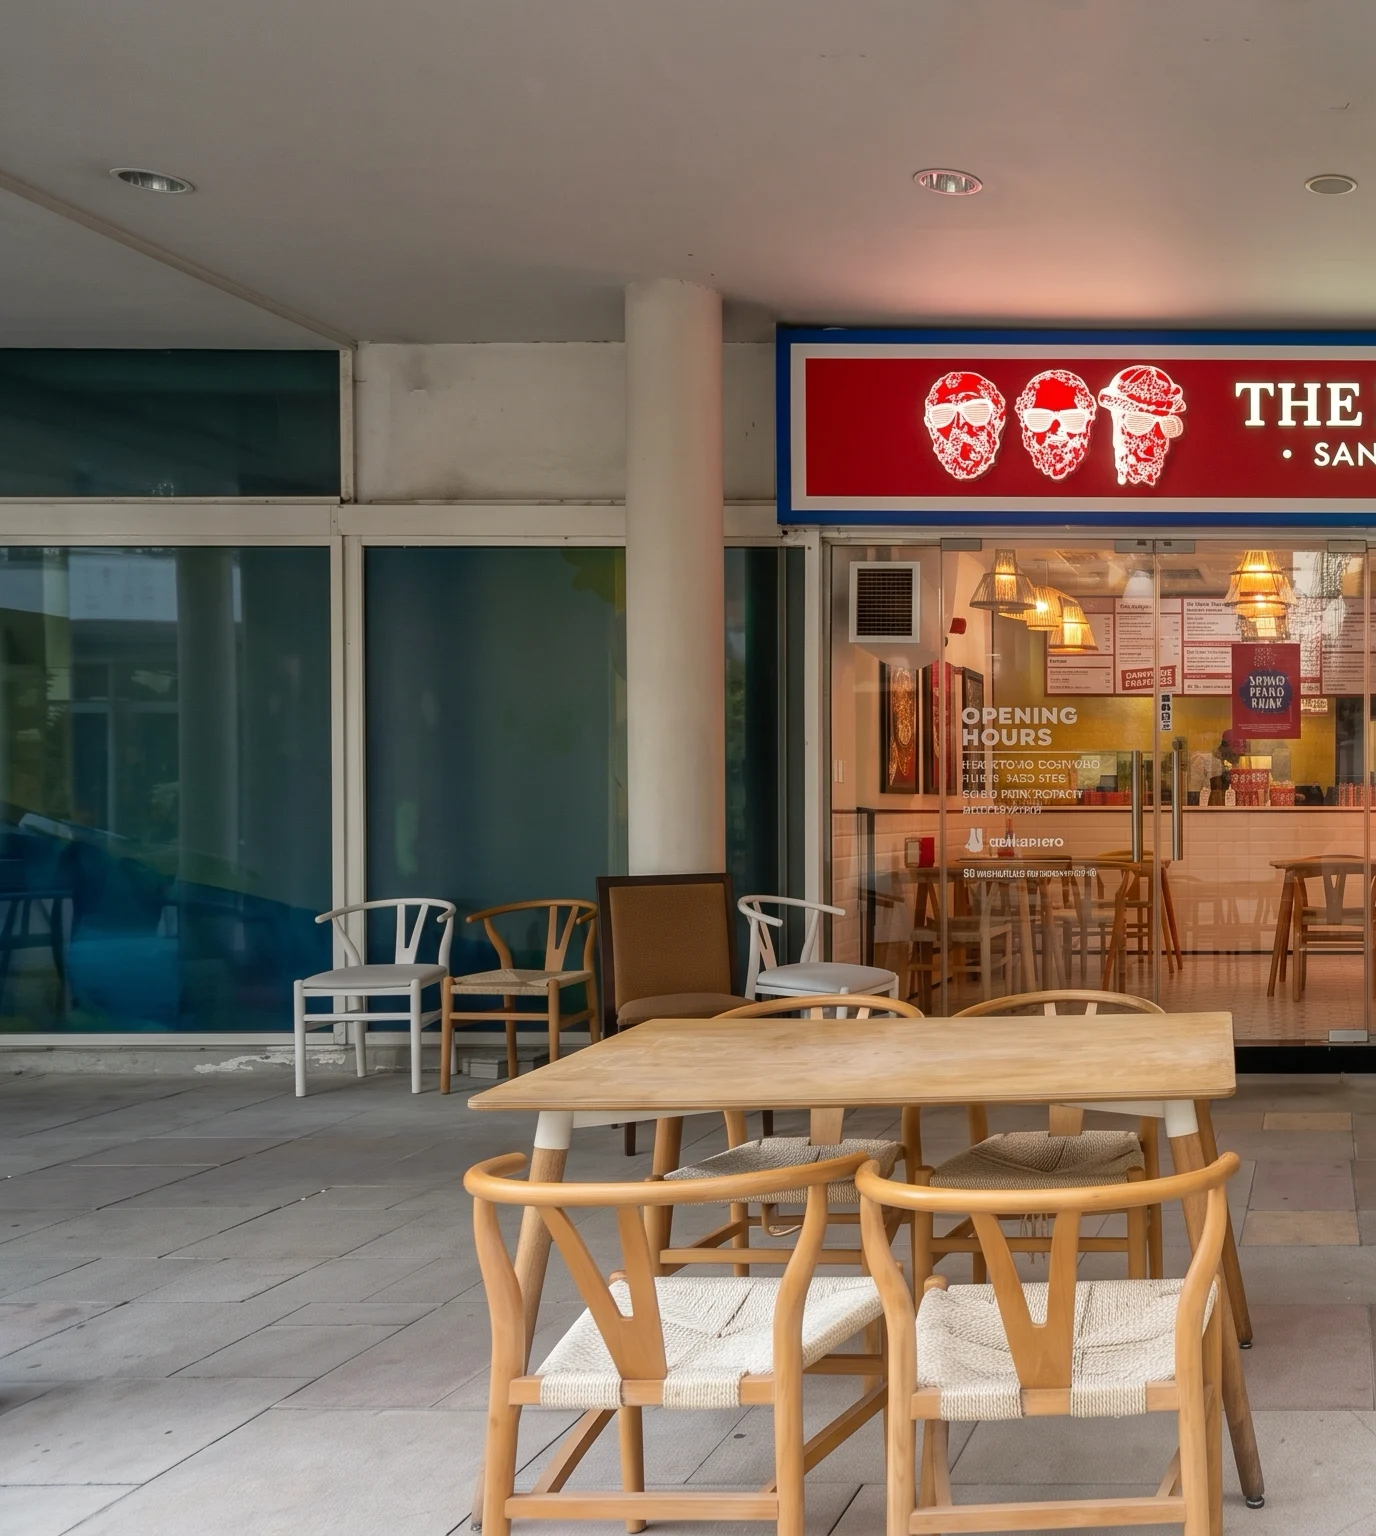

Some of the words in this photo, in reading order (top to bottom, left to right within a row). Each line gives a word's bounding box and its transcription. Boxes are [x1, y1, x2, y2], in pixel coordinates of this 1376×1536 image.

[1235, 382, 1363, 427] THE
[961, 707, 1078, 725] OPENING
[962, 728, 1053, 746] HOURS
